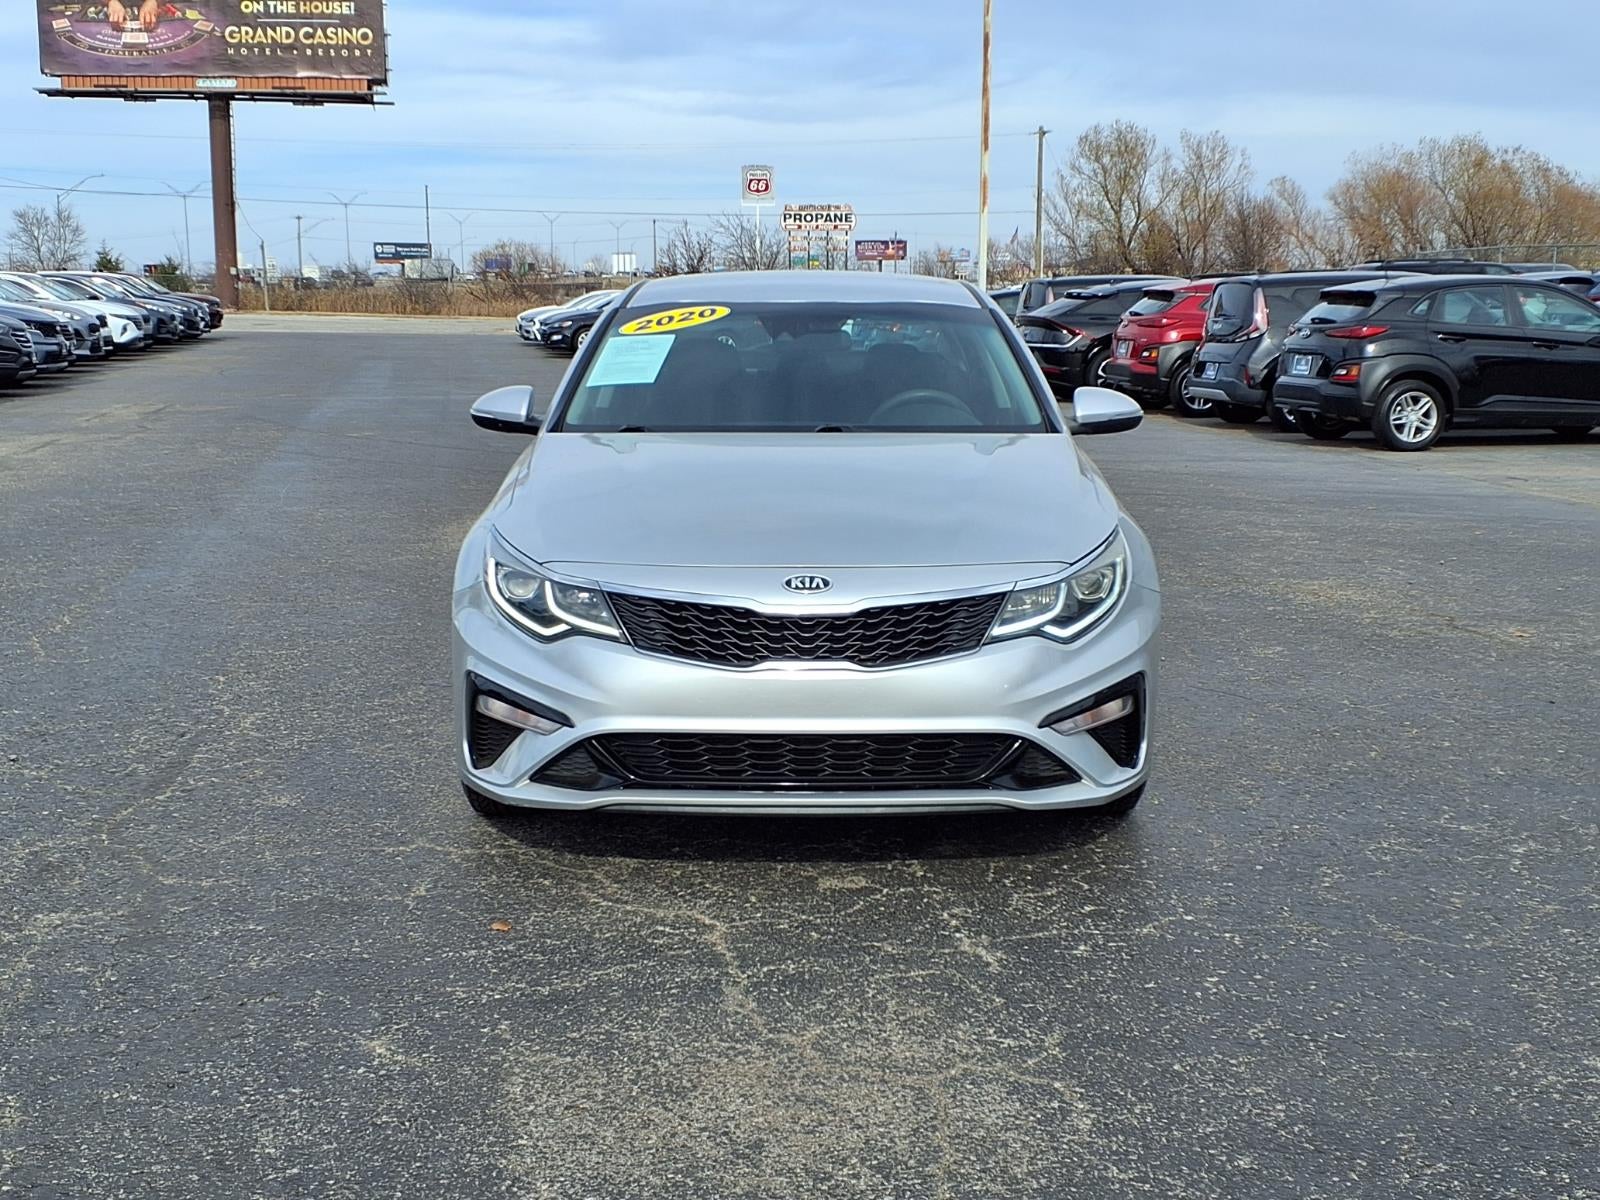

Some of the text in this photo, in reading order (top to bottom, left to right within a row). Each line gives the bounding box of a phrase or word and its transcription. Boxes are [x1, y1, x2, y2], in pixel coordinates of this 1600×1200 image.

[241, 1, 355, 15] ON THE HOUSE!
[224, 26, 373, 45] GRAND CASINO
[228, 47, 373, 57] HOTEL RESORT
[750, 180, 767, 191] 66
[783, 212, 854, 223] PROPANE
[634, 307, 717, 332] 2020
[791, 577, 825, 588] KIA
